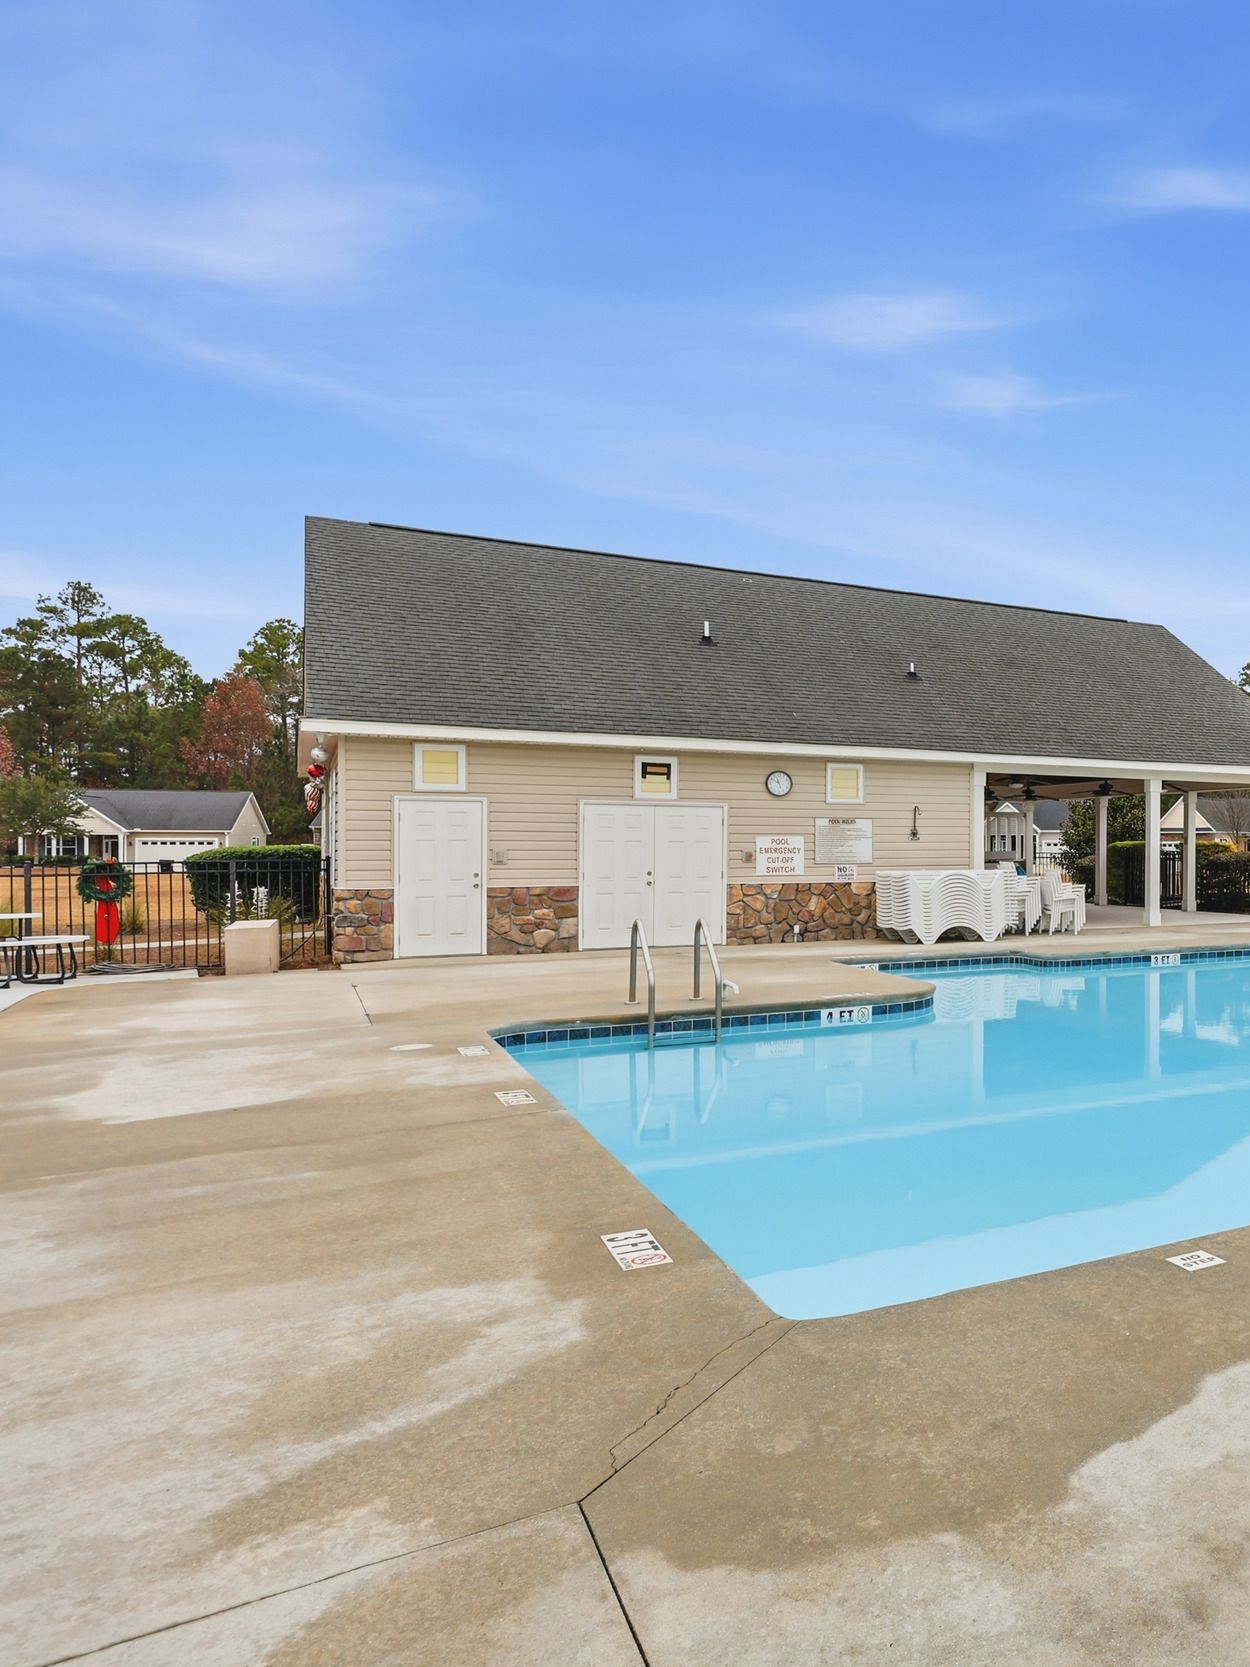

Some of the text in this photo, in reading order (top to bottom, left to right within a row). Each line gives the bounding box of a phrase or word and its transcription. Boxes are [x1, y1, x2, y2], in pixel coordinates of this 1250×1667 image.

[759, 847, 801, 855] EMERGENCY
[766, 856, 795, 864] CUT-OFF
[606, 1232, 661, 1256] 3 FT
[1182, 1257, 1216, 1267] STEP
